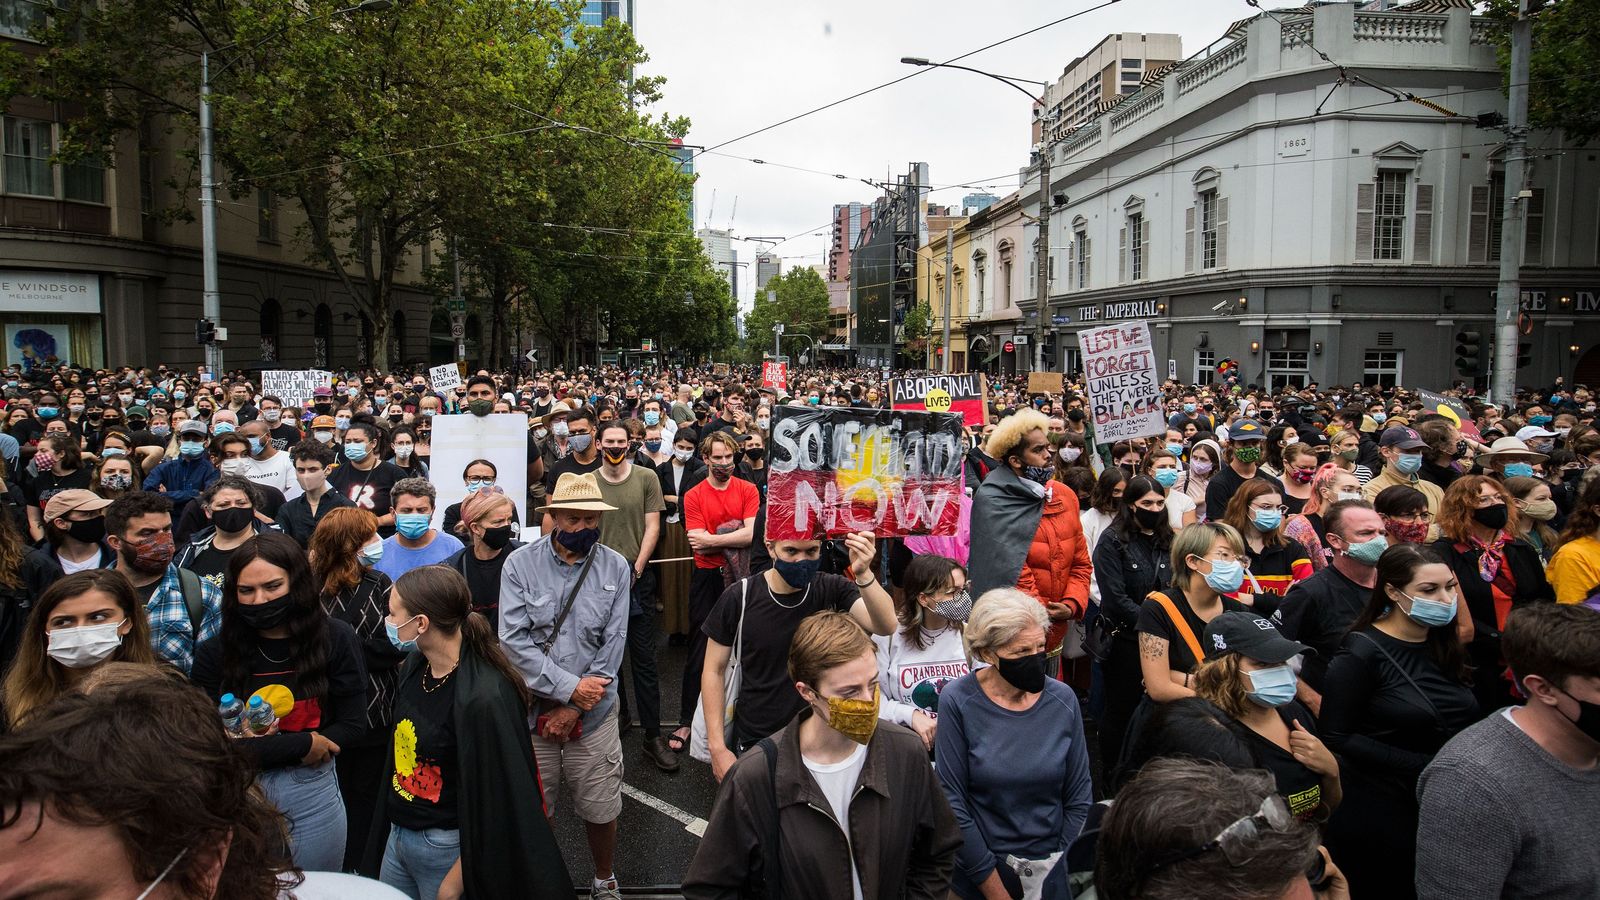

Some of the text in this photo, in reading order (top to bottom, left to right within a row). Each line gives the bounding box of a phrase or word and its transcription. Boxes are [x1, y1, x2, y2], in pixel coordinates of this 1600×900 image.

[1284, 138, 1306, 148] 1863
[18, 282, 87, 293] WINDSOR
[9, 293, 63, 301] MELBOURNE
[1079, 300, 1158, 321] THE IMPERIAL
[1121, 327, 1142, 346] WE
[1086, 350, 1151, 378] FORGET
[264, 371, 298, 381] ALWAYS
[303, 371, 323, 381] WAS
[1090, 371, 1151, 394] UNLESS
[264, 380, 292, 389] ALWAYS
[295, 380, 312, 390] WILL
[925, 396, 950, 407] LIVES
[1092, 384, 1155, 405] THEY WERE
[1095, 396, 1160, 424] BLACK
[1103, 422, 1124, 431] ZIGGY
[1103, 430, 1124, 439] APRIL
[795, 477, 950, 532] NOW
[901, 664, 968, 689] CRANBERRIES
